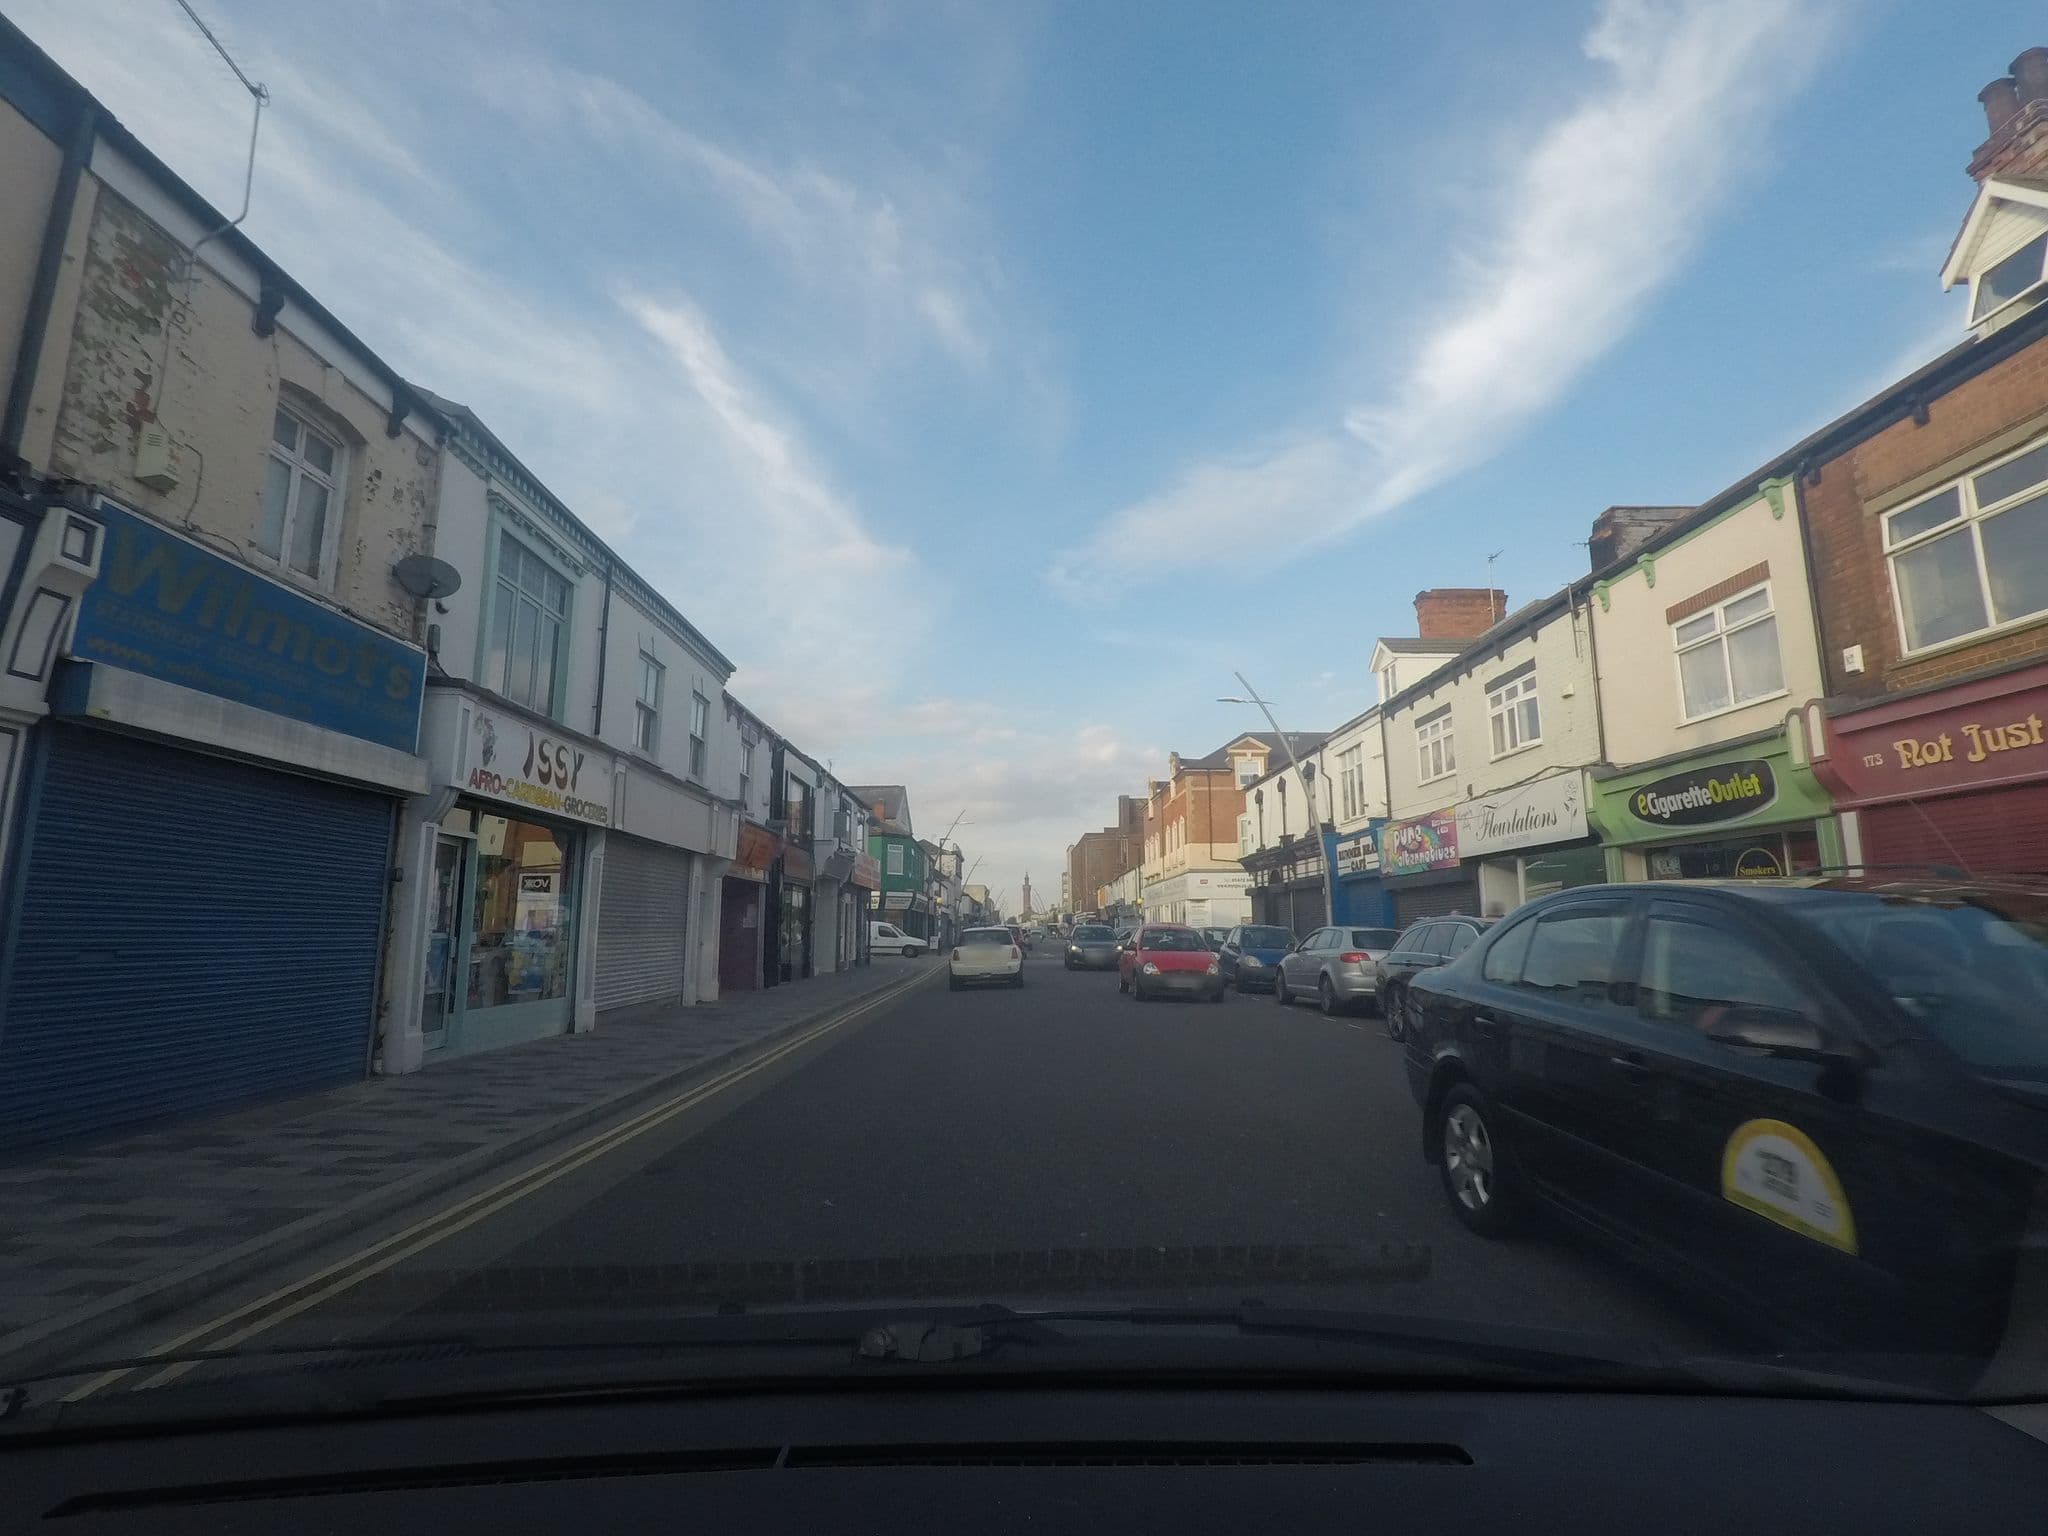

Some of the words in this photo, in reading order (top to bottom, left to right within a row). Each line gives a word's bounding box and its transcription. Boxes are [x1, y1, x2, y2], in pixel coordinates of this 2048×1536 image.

[522, 731, 585, 793] ISSY
[1893, 732, 1954, 769] Not
[1961, 713, 2045, 762] Just
[1739, 866, 1776, 876] Smokers
